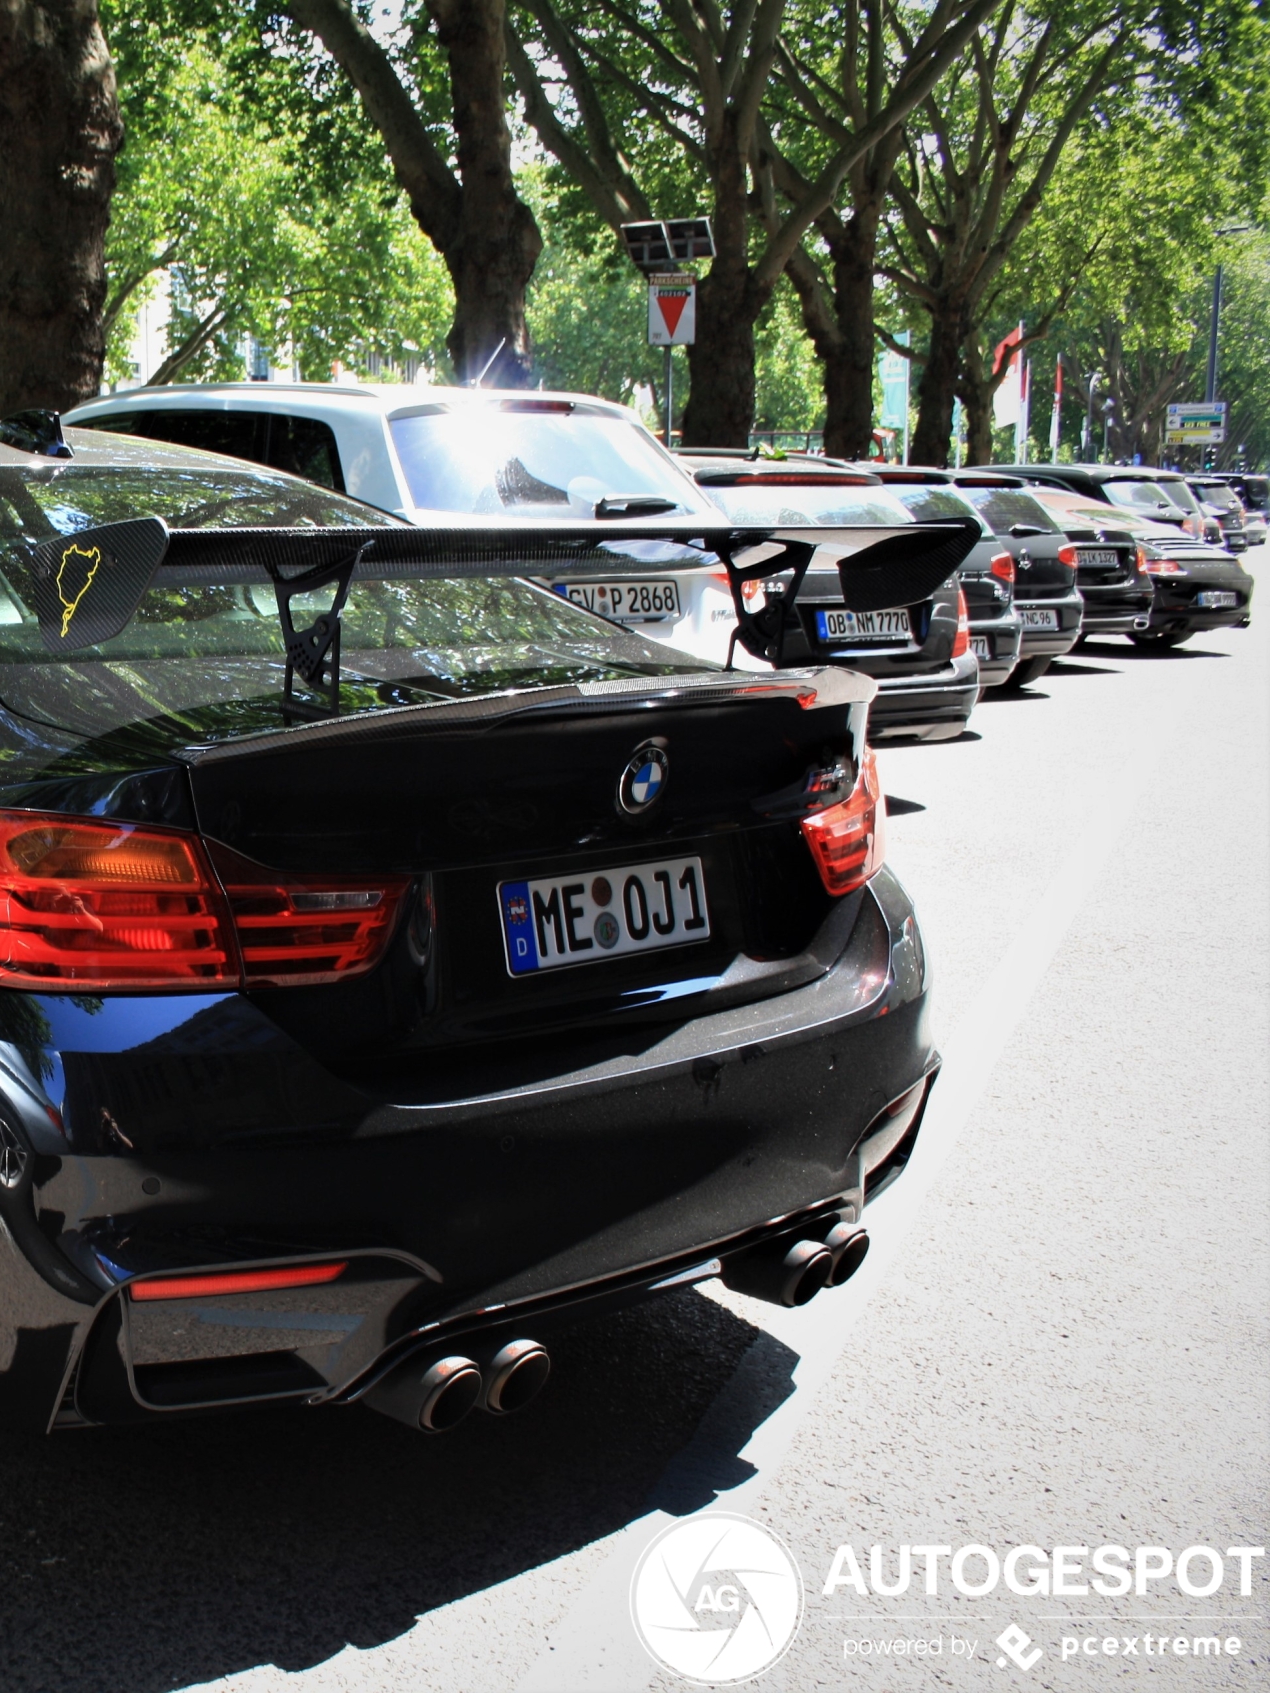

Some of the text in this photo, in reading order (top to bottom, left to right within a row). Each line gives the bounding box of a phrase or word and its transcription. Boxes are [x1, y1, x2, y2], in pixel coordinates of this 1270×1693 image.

[610, 588, 622, 614] P
[627, 586, 675, 613] 2868
[827, 612, 909, 635] OB NM 7770
[1025, 611, 1051, 626] NC 96
[532, 866, 705, 958] ME OJ1
[516, 937, 528, 957] D
